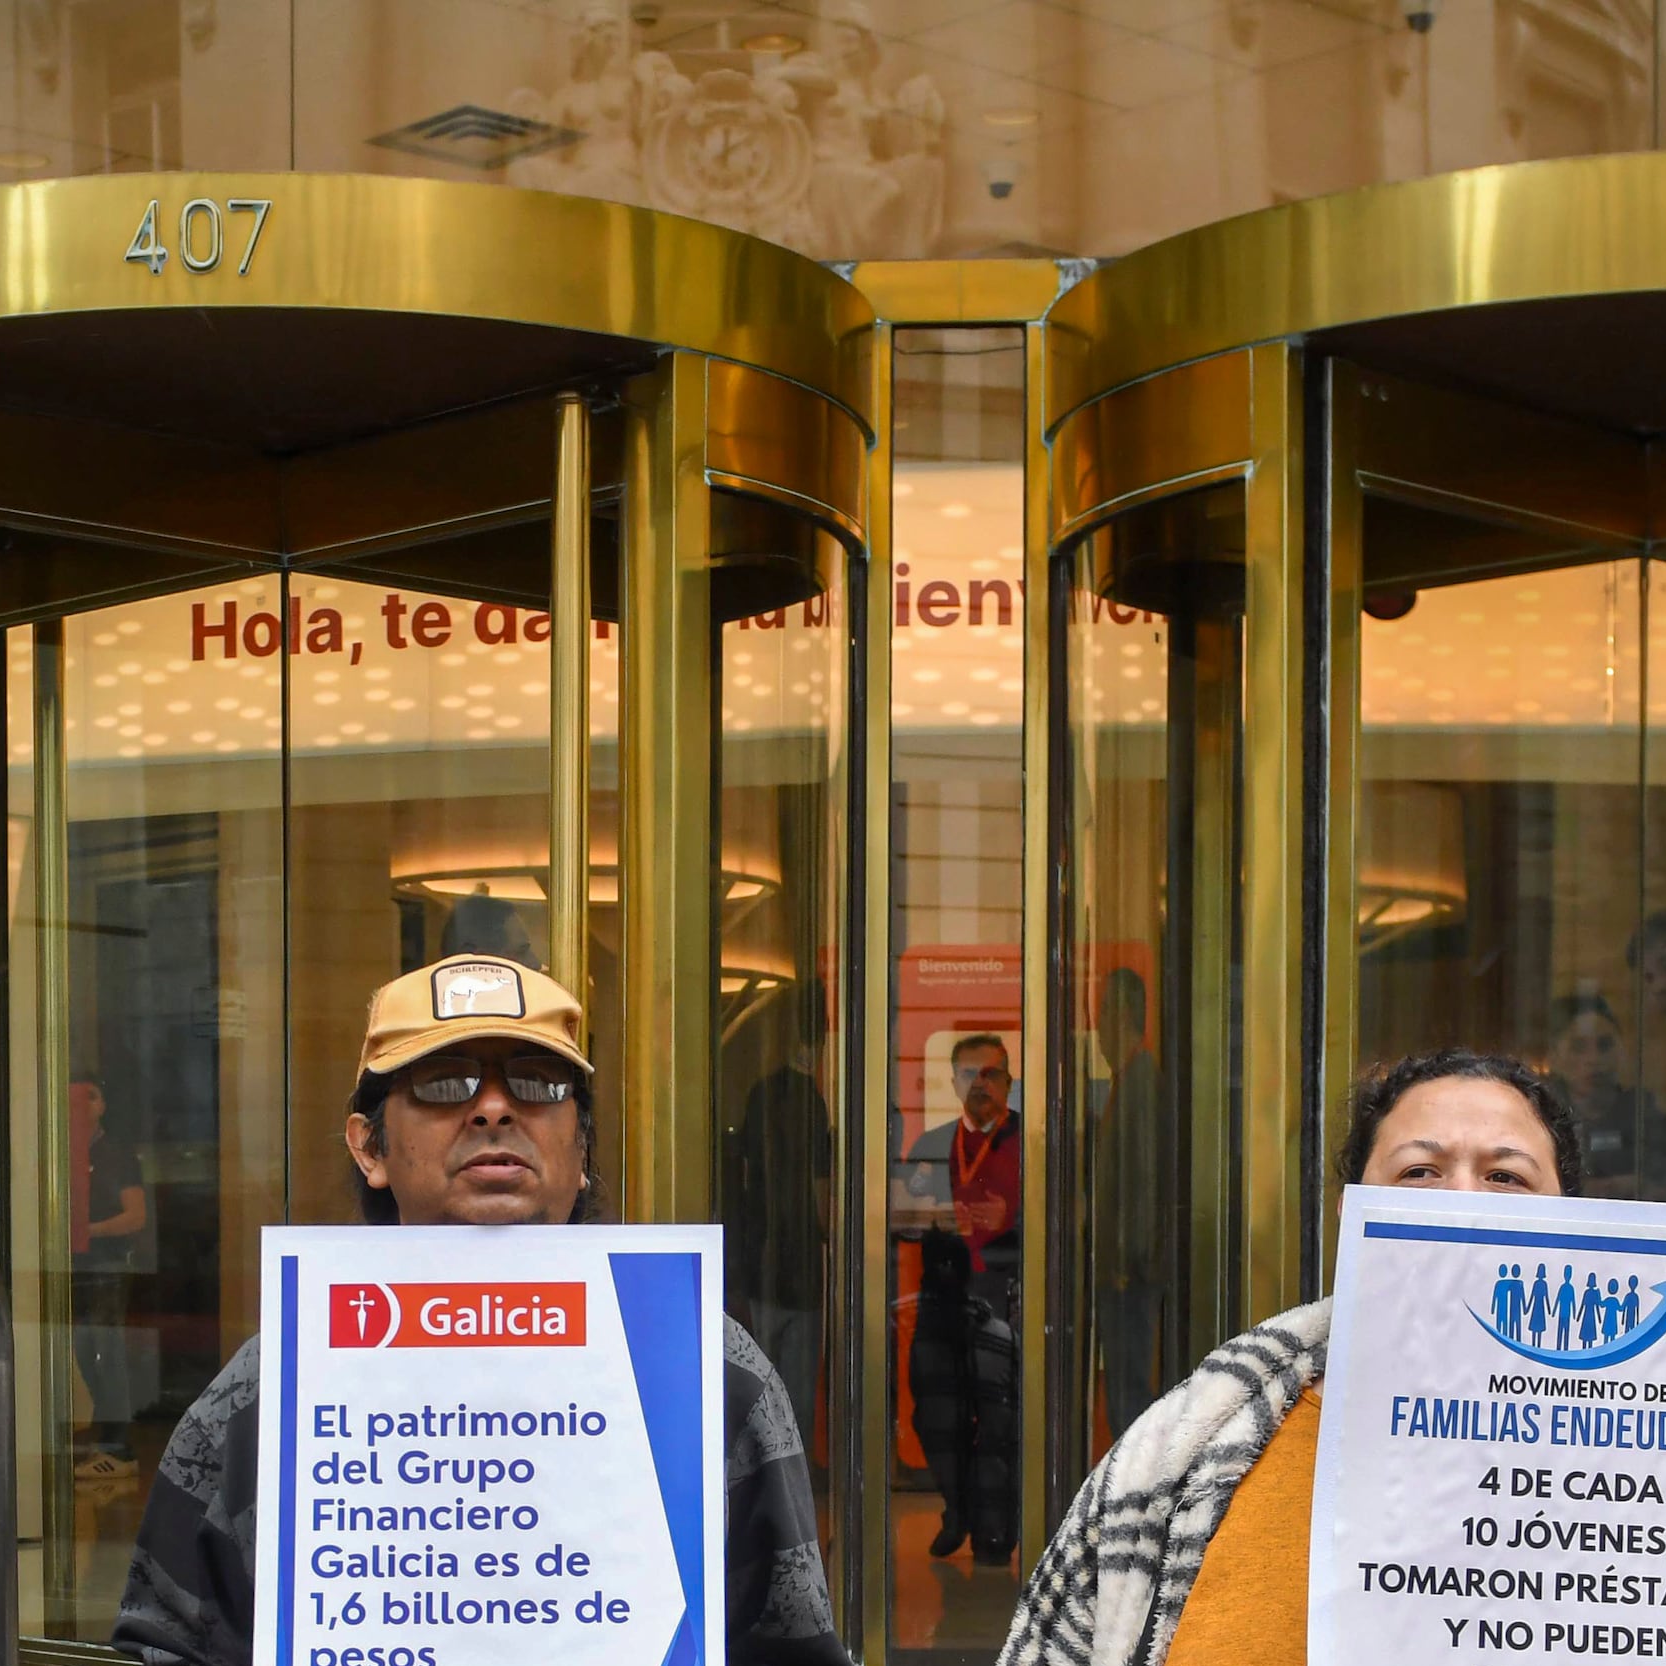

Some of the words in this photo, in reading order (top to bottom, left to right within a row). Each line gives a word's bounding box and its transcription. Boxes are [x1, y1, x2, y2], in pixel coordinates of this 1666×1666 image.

[123, 198, 274, 276] 407
[191, 596, 363, 666] Hola,
[381, 594, 452, 649] te
[918, 959, 1004, 974] Bienvenido
[419, 1294, 566, 1336] Galicia
[1488, 1373, 1637, 1401] MOVIMIENTO
[313, 1404, 352, 1438] El
[367, 1402, 607, 1447] patrimonio
[1390, 1395, 1541, 1444] FAMILIAS
[312, 1451, 383, 1485] del
[397, 1449, 535, 1493] Grupo
[1477, 1466, 1501, 1495] 4
[1510, 1467, 1552, 1499] DE
[1562, 1470, 1664, 1504] CADA
[312, 1496, 539, 1532] Financiero
[1461, 1516, 1498, 1547] 10
[310, 1543, 458, 1579] Galicia
[473, 1552, 520, 1578] es
[534, 1543, 591, 1577] de
[1357, 1562, 1543, 1600] TOMARON
[309, 1591, 366, 1631] 1,6
[382, 1590, 560, 1625] billones
[574, 1589, 630, 1624] de
[1442, 1617, 1469, 1648] Y
[1478, 1619, 1534, 1651] NO
